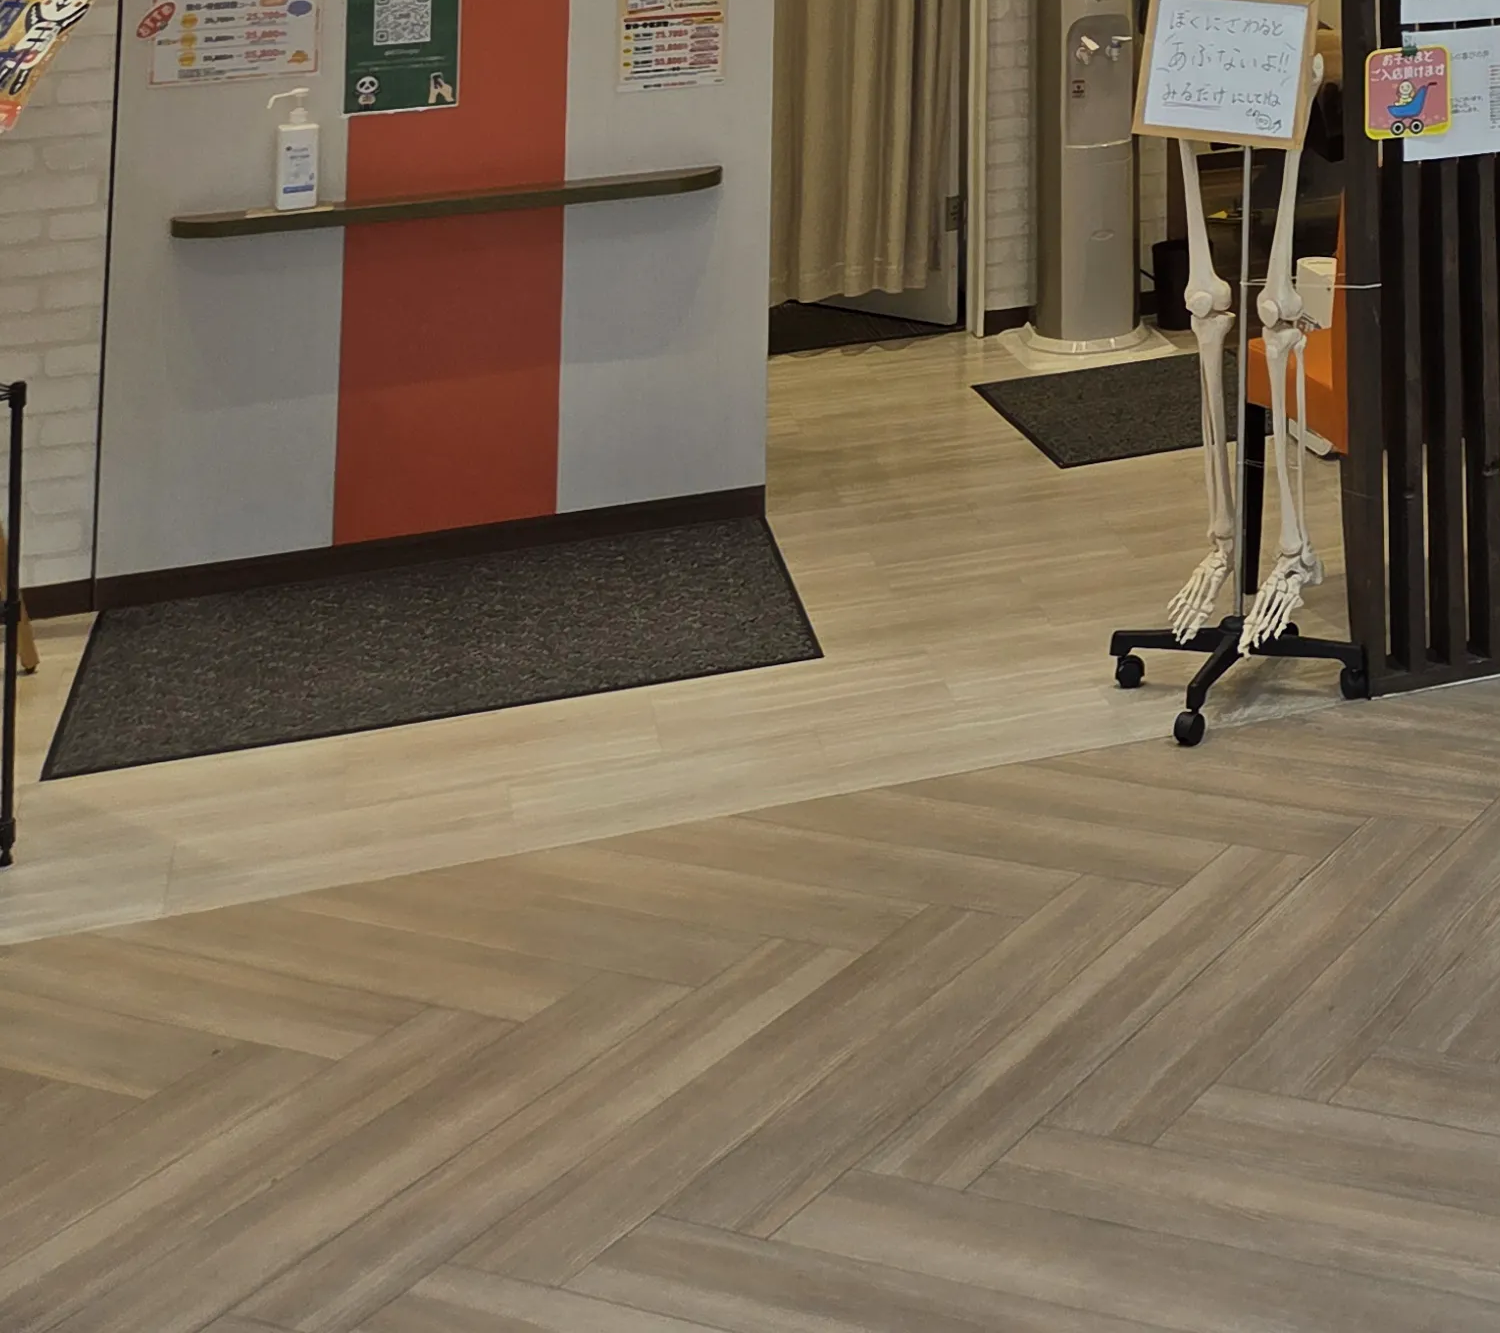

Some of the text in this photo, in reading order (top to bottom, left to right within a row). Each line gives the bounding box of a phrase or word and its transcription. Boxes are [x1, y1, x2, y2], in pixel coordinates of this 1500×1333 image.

[1169, 10, 1285, 36] ぼくにさわると
